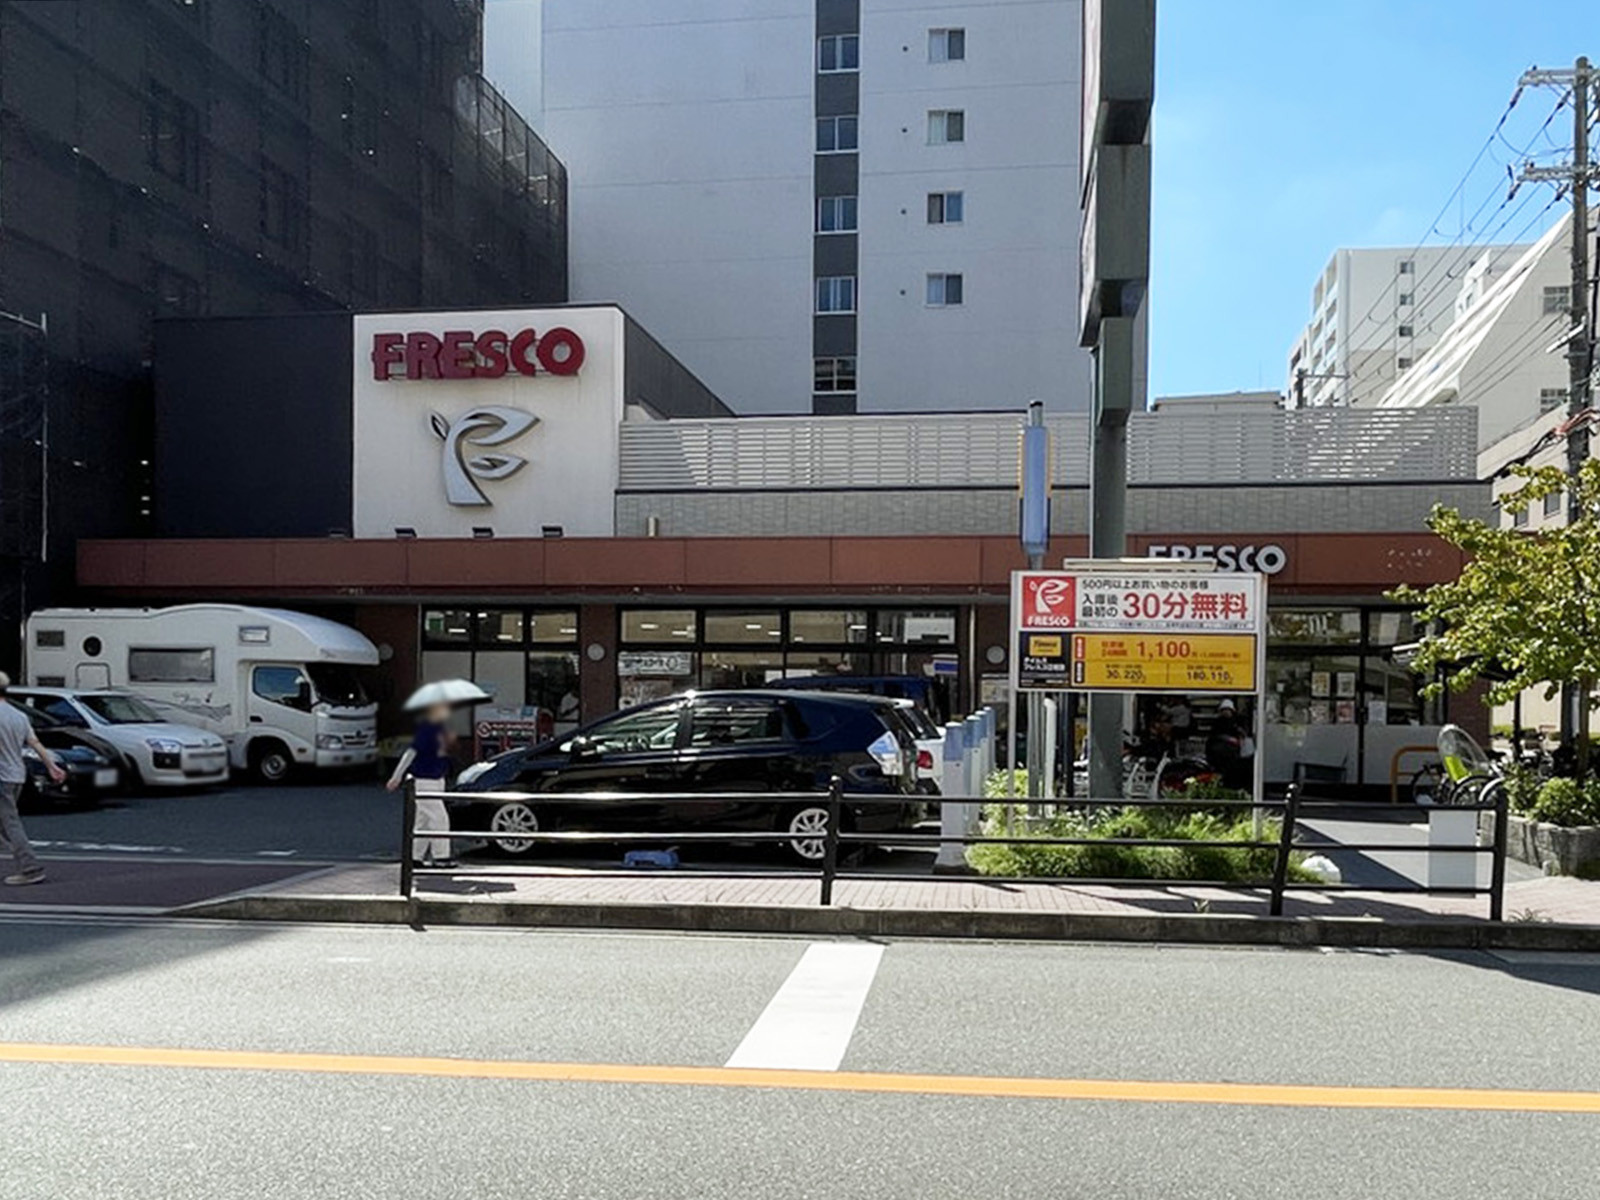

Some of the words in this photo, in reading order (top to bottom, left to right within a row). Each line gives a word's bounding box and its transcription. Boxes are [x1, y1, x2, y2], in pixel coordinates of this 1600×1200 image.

[371, 327, 586, 381] FRESCO
[1123, 592, 1248, 620] 30分無料
[1027, 615, 1070, 627] FRESCO
